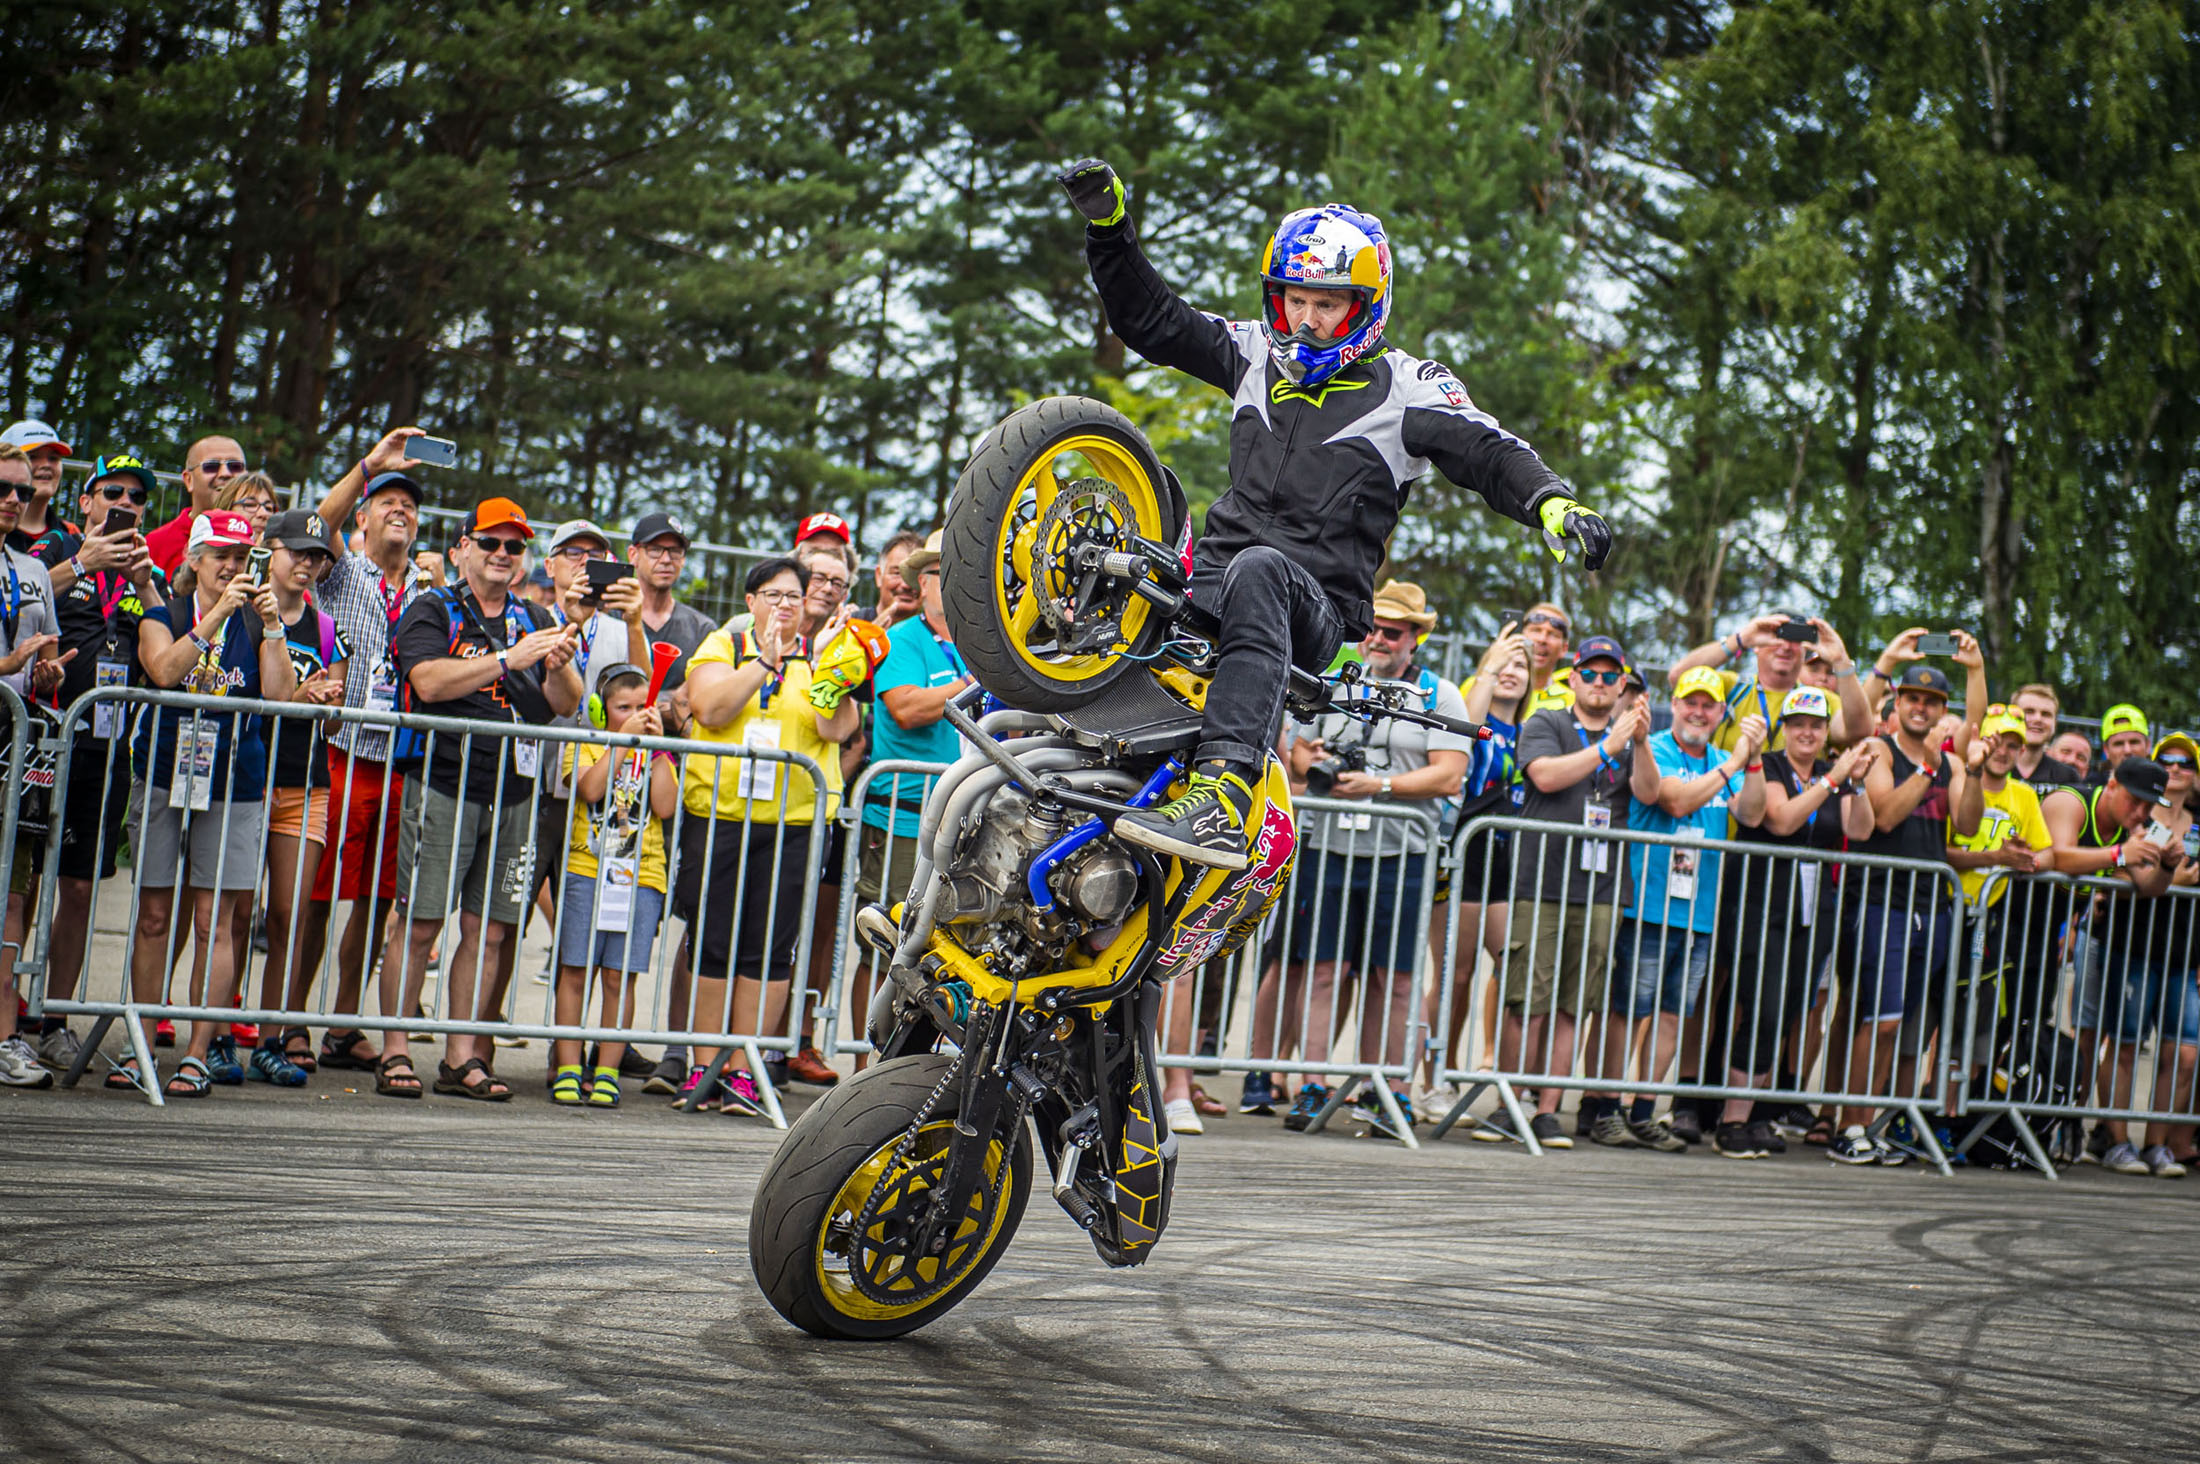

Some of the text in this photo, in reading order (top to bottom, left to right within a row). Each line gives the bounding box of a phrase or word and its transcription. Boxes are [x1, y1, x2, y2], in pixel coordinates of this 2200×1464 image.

[1304, 234, 1322, 243] Arai
[1285, 266, 1325, 280] Red Bull
[1340, 327, 1372, 366] Red
[118, 597, 144, 616] 46
[1192, 896, 1237, 931] Red
[1157, 931, 1200, 966] Bull
